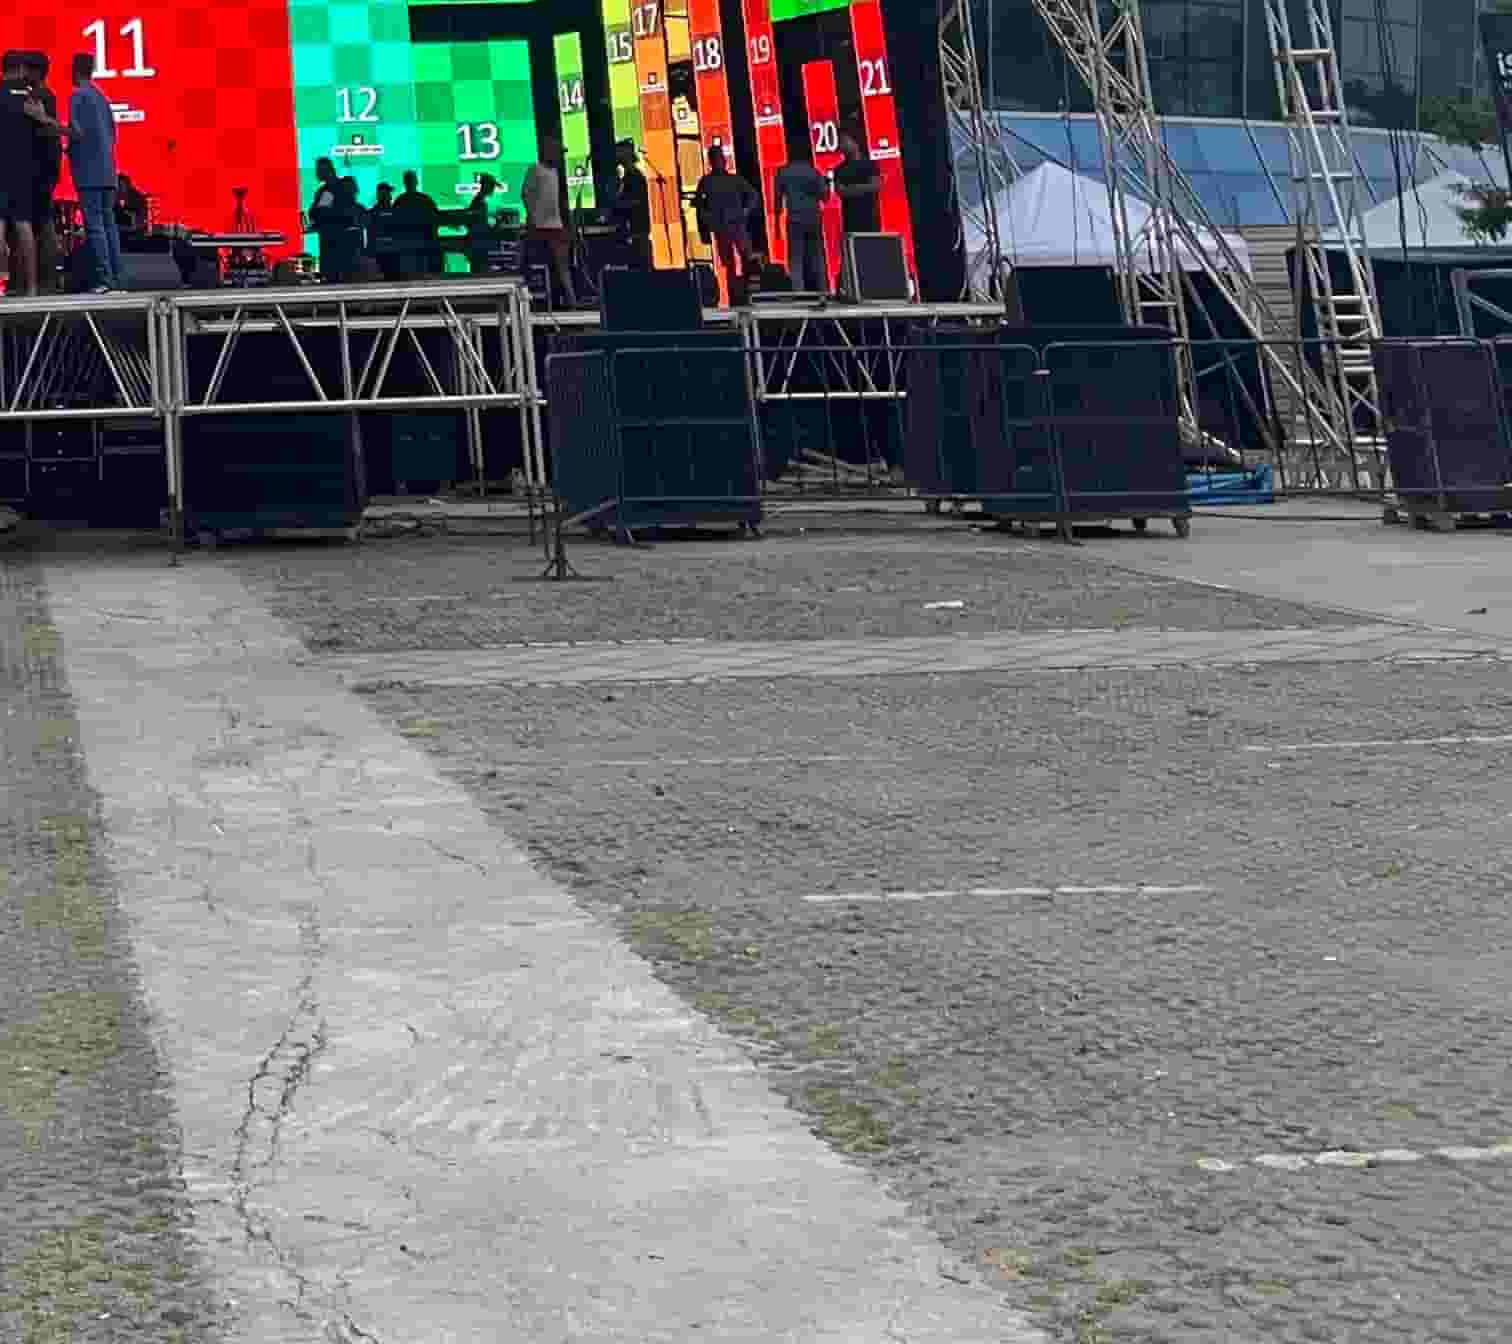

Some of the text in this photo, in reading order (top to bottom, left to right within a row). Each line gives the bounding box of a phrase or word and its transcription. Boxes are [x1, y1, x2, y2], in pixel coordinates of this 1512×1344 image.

[634, 5, 659, 35] 17
[82, 17, 156, 78] 11
[608, 35, 632, 63] 15
[693, 40, 722, 72] 18
[749, 35, 771, 64] 19
[860, 61, 892, 96] 21
[335, 87, 378, 122] 12
[560, 82, 584, 112] 14
[456, 123, 500, 160] 13
[814, 124, 839, 152] 20
